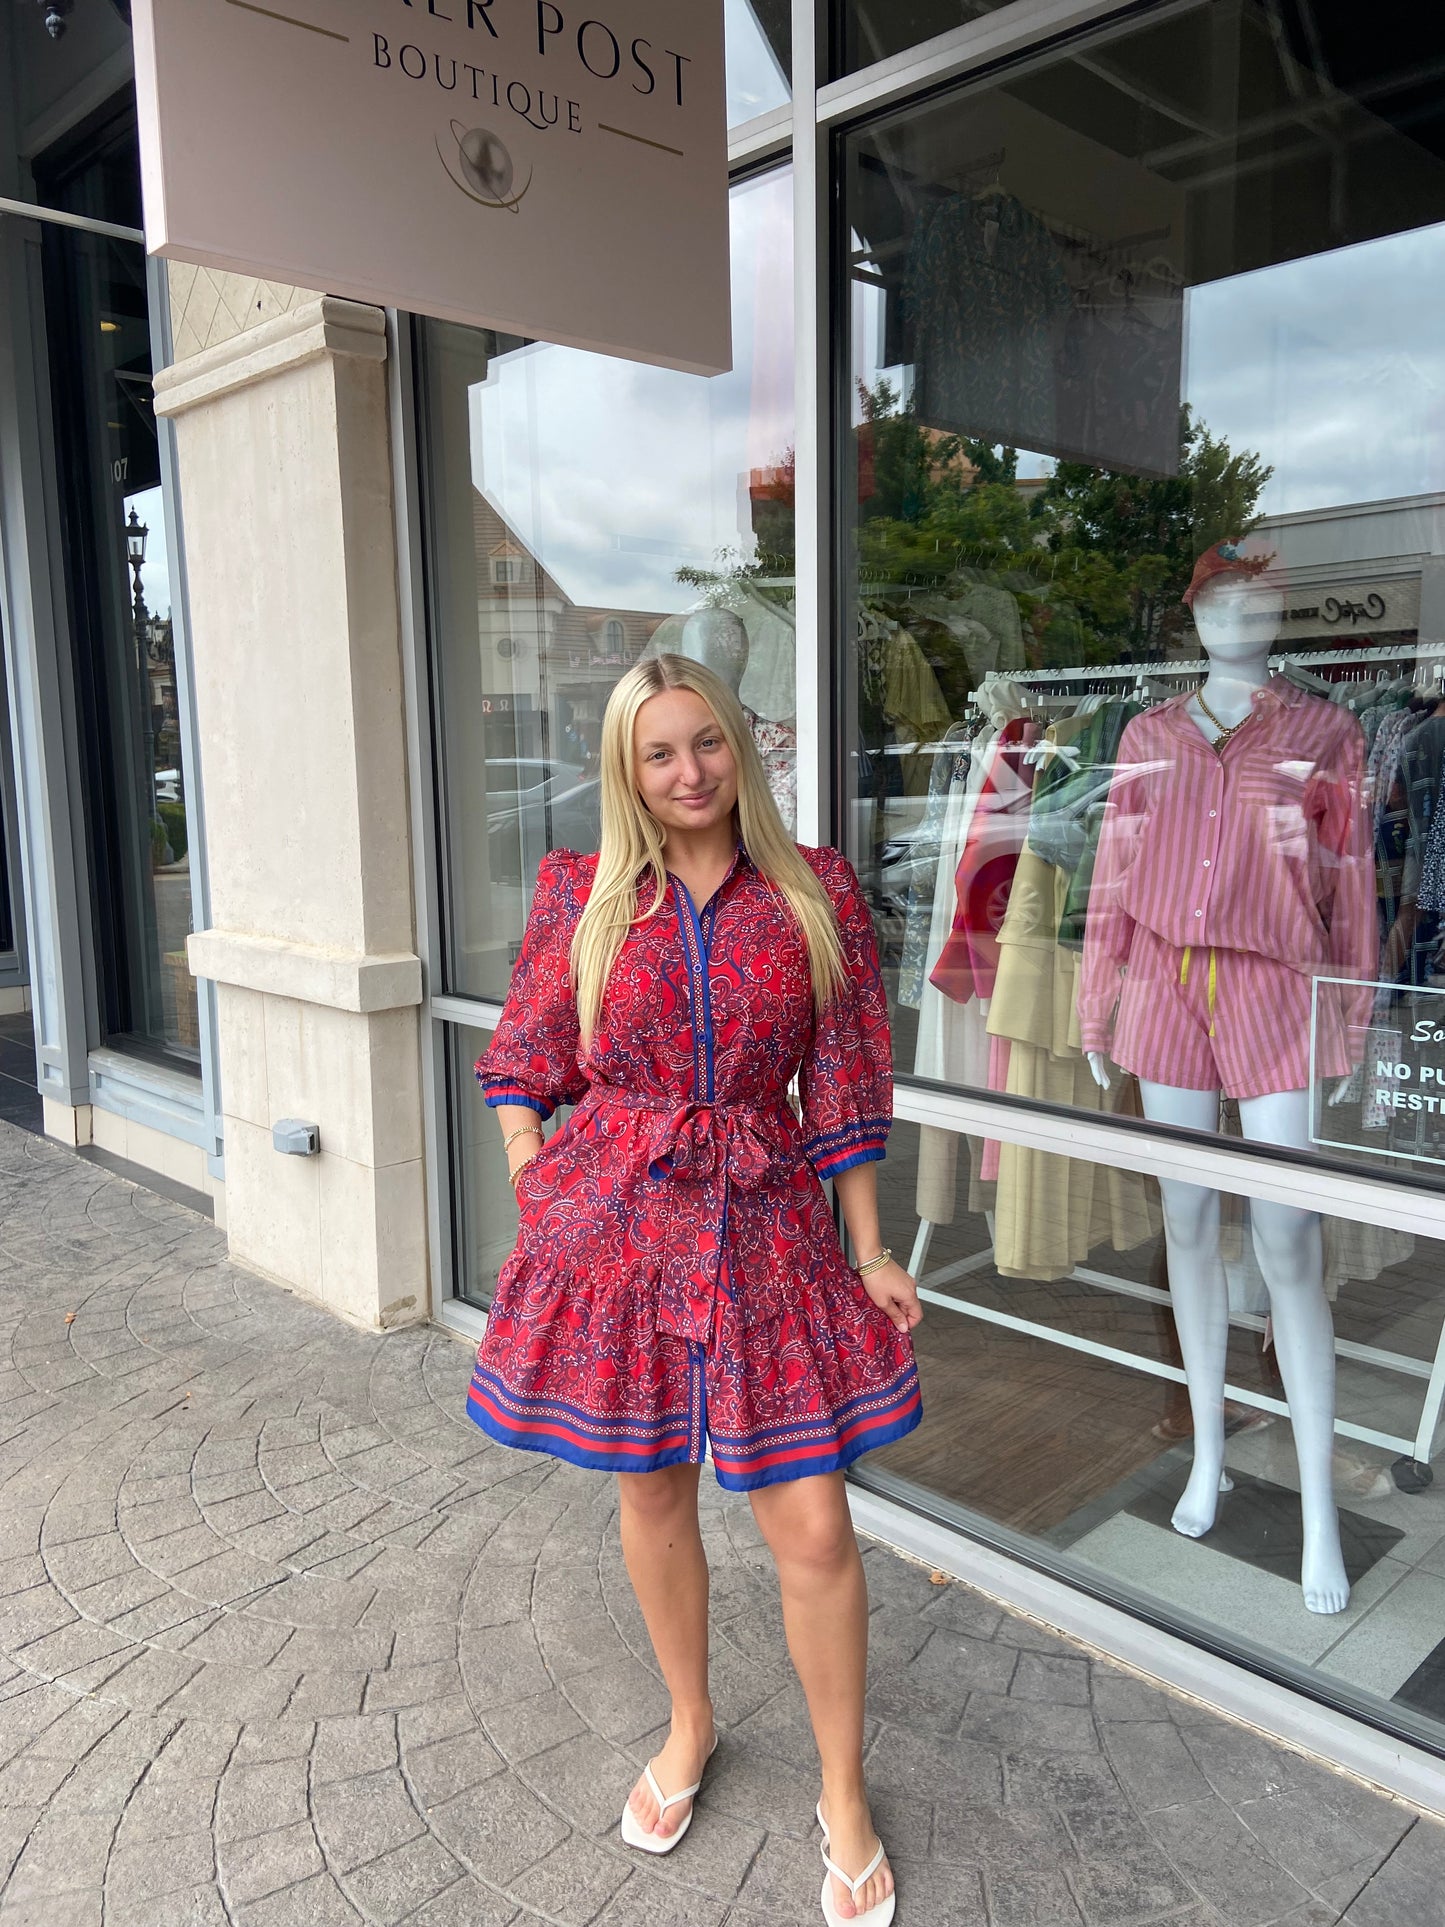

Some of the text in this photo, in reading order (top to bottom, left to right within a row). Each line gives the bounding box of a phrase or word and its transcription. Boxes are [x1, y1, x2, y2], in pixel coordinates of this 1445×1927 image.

[372, 32, 583, 133] BOUTIQUE
[537, 0, 692, 106] POST
[1376, 1060, 1411, 1080] NO
